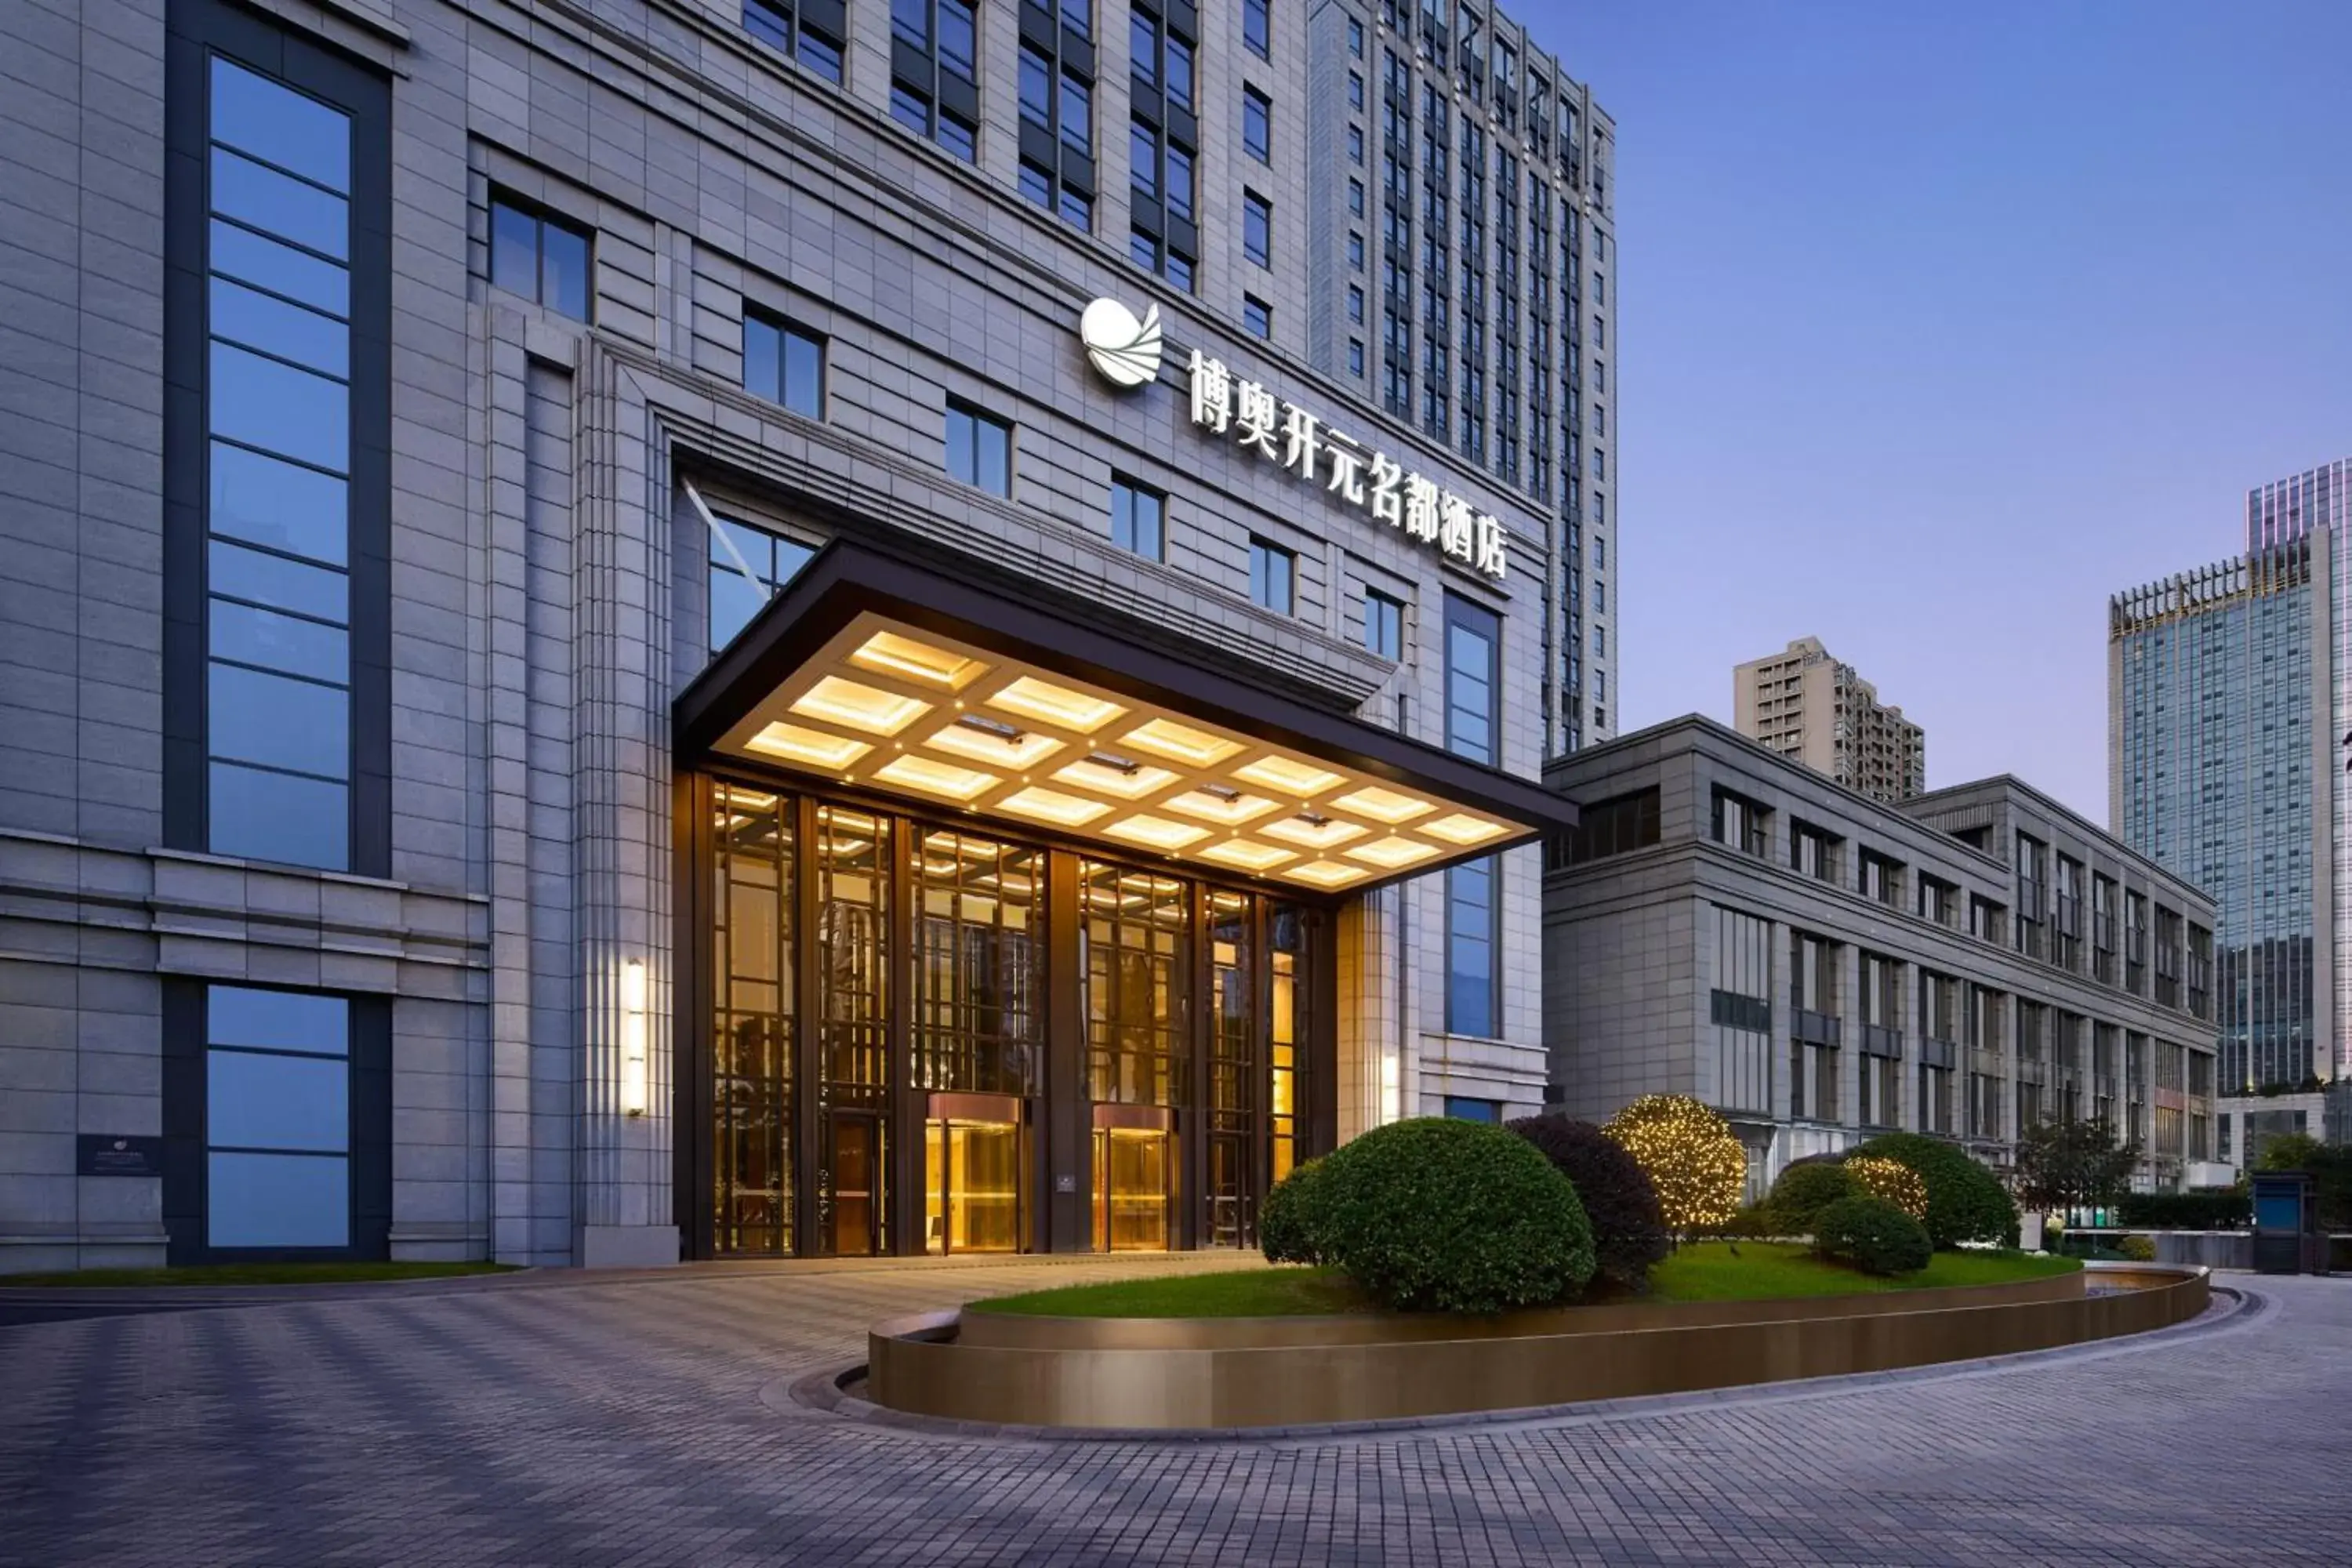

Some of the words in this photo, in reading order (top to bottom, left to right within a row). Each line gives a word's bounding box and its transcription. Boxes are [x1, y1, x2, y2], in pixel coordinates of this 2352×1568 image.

[1187, 349, 1508, 580] 博奥开元名都酒店
